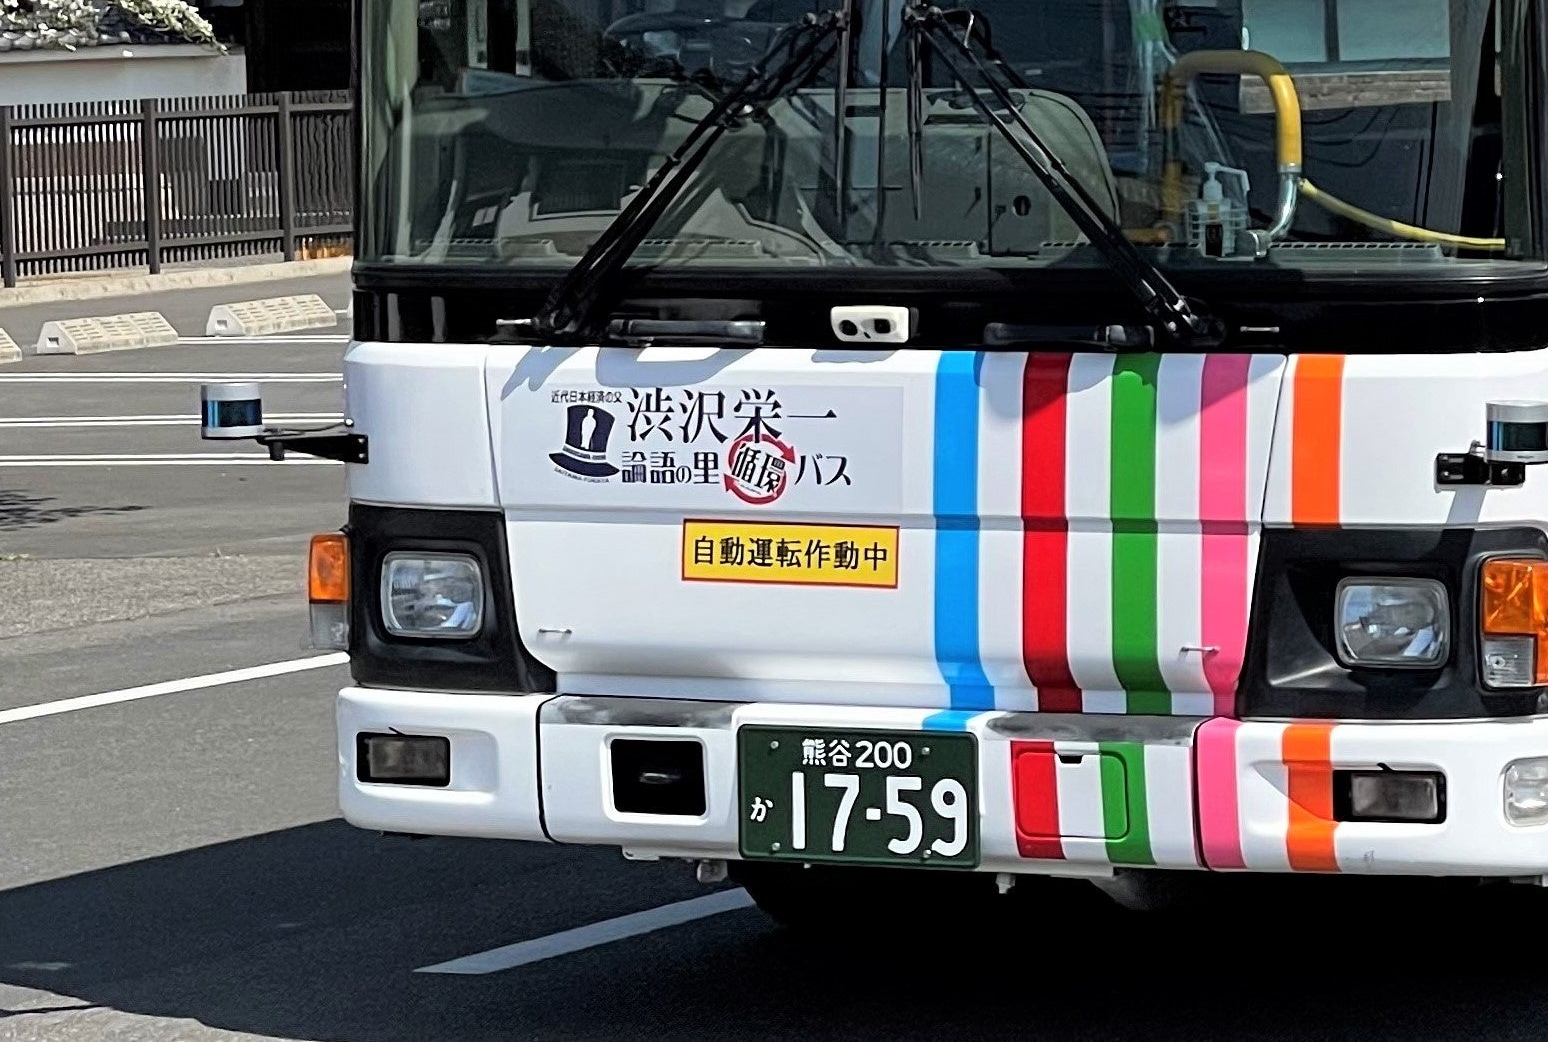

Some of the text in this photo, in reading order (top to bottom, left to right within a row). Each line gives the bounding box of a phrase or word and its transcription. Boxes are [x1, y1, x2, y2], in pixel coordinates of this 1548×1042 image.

[551, 390, 623, 404] 近代日本経済の父
[626, 386, 838, 444] 渋沢栄一
[693, 535, 888, 571] 自動運転作動中
[750, 771, 968, 857] か 17-59
